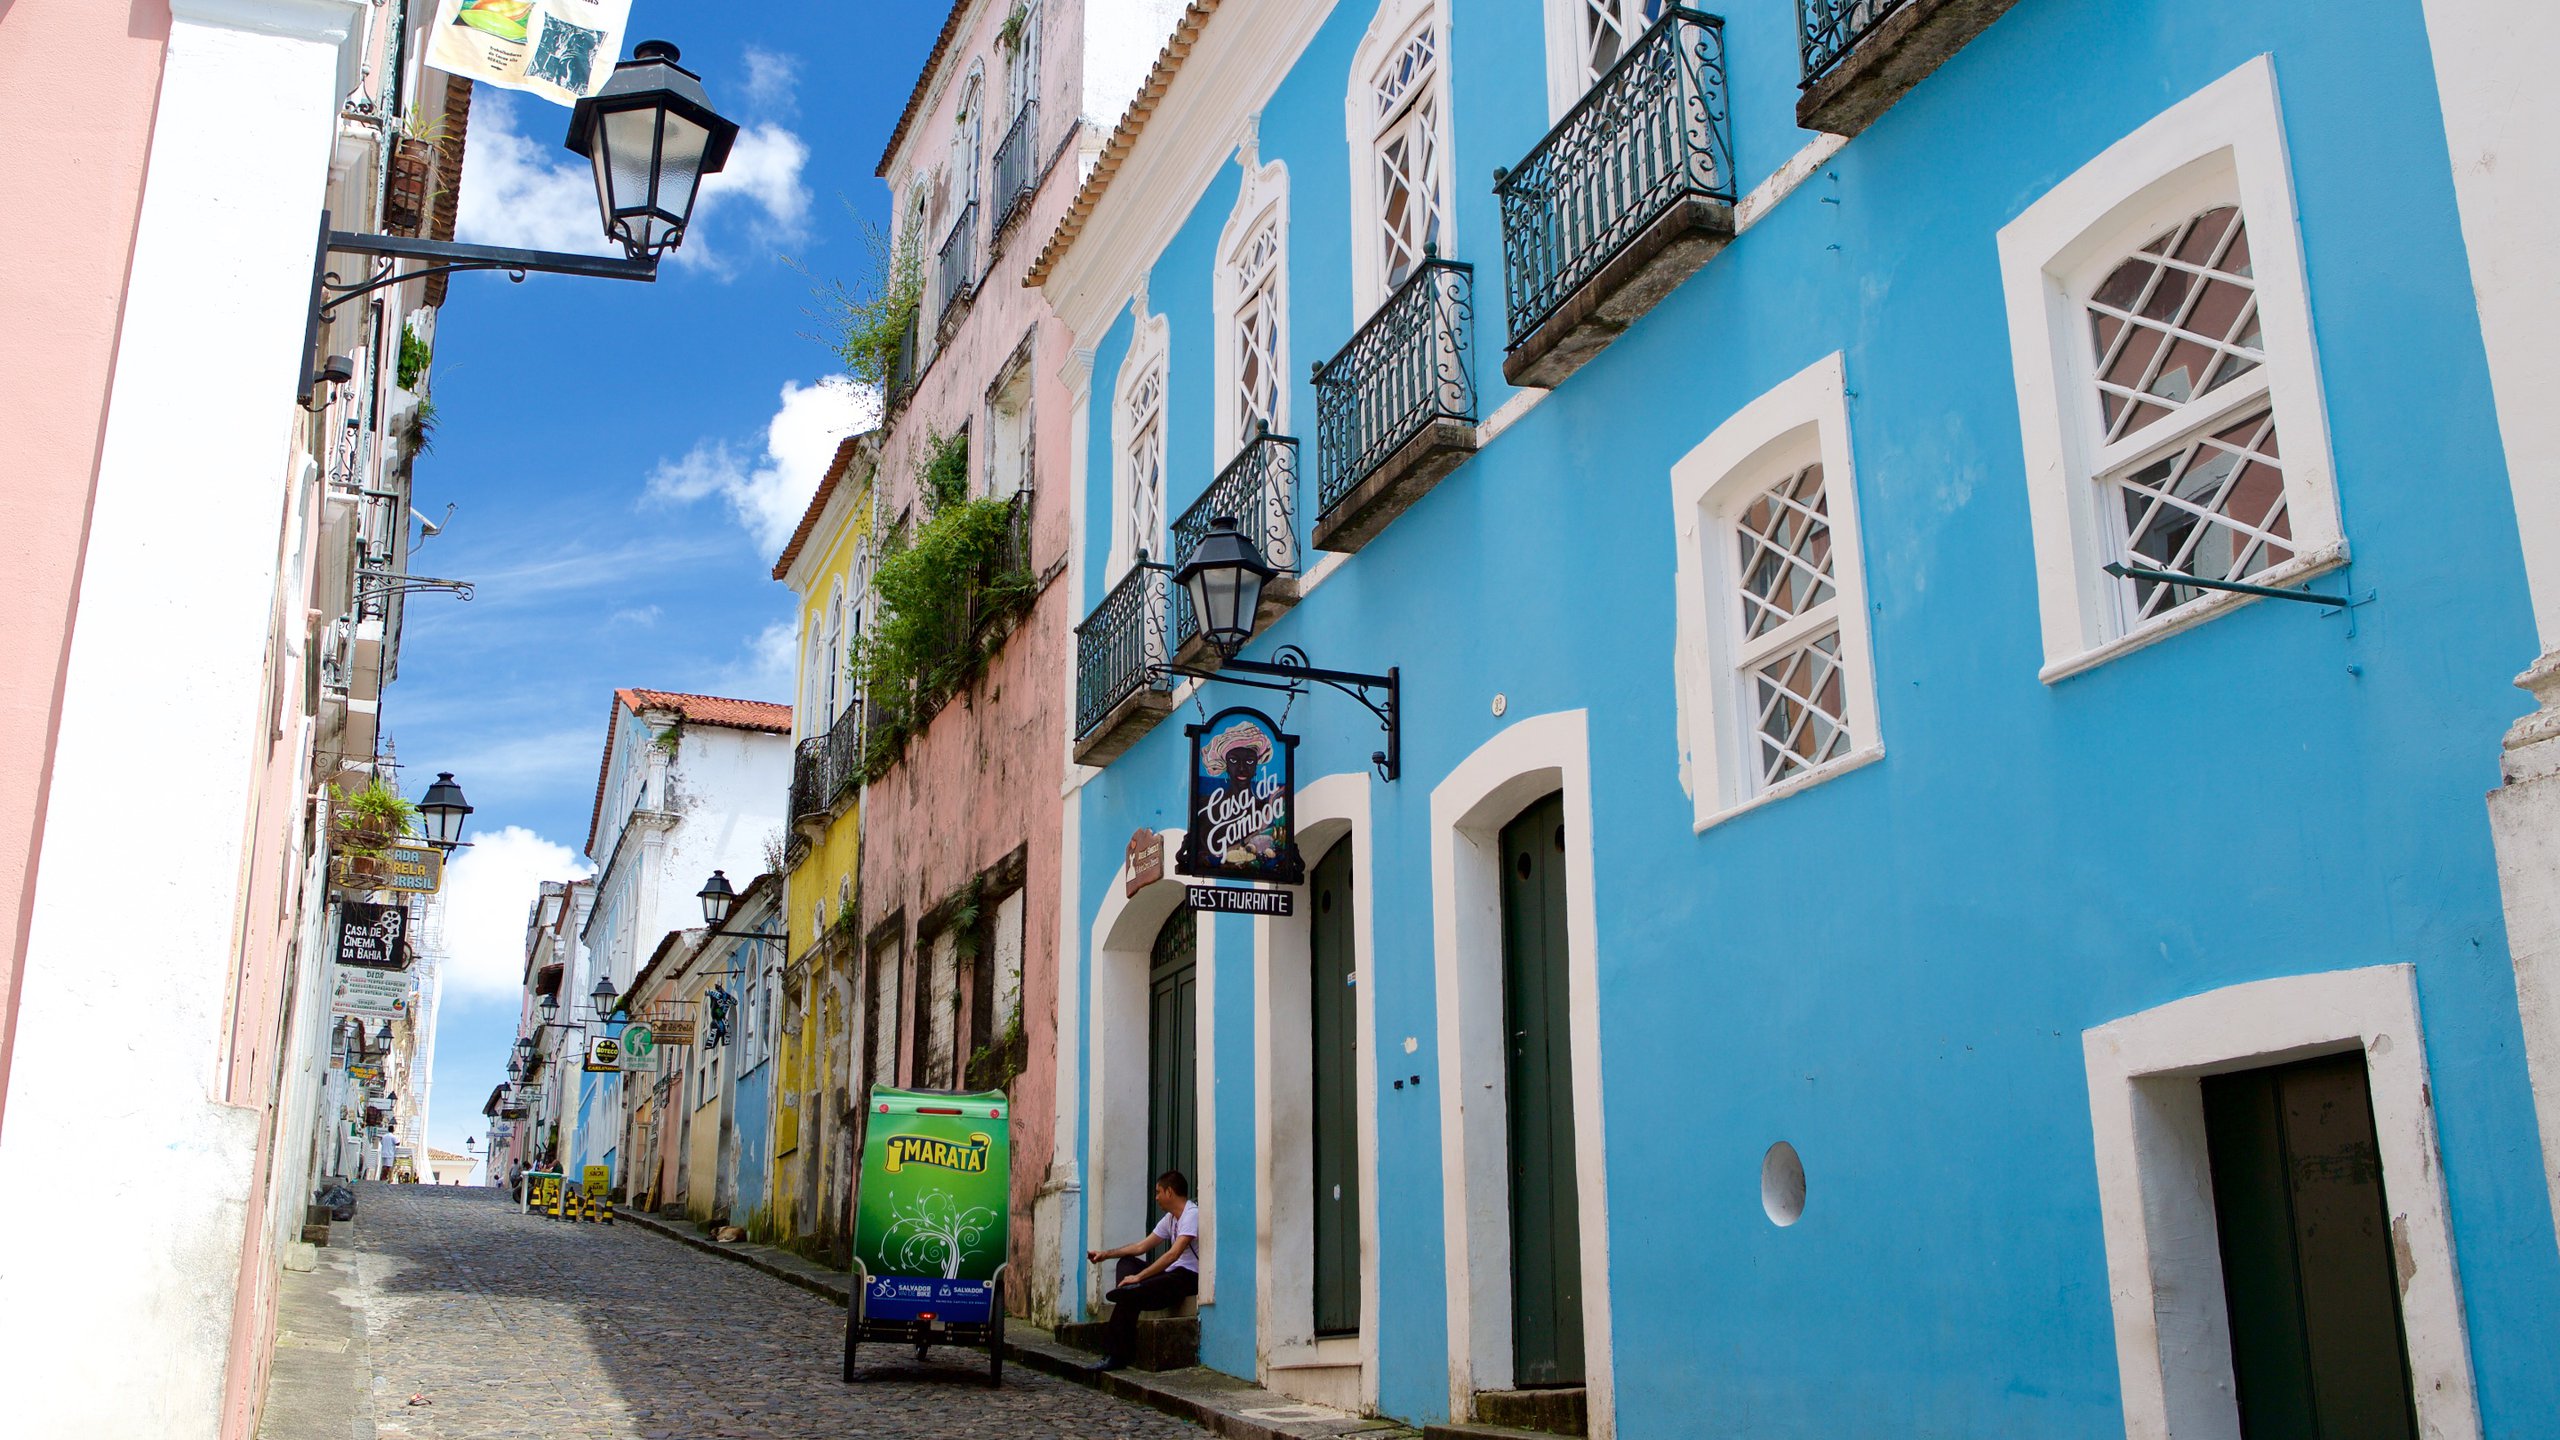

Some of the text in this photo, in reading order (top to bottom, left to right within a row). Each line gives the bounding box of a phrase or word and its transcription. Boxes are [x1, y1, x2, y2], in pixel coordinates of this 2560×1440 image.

[1198, 766, 1280, 825] Casa da
[1206, 796, 1285, 864] Gamboa
[394, 850, 419, 862] ADA
[393, 863, 426, 876] RELA
[1190, 887, 1288, 913] RESTAURANTE
[345, 923, 382, 937] CASA DE
[343, 935, 376, 948] CINEMA
[342, 947, 382, 960] DA BAHIA
[596, 1047, 618, 1055] BOTECO
[904, 1139, 986, 1170] MARATÁ
